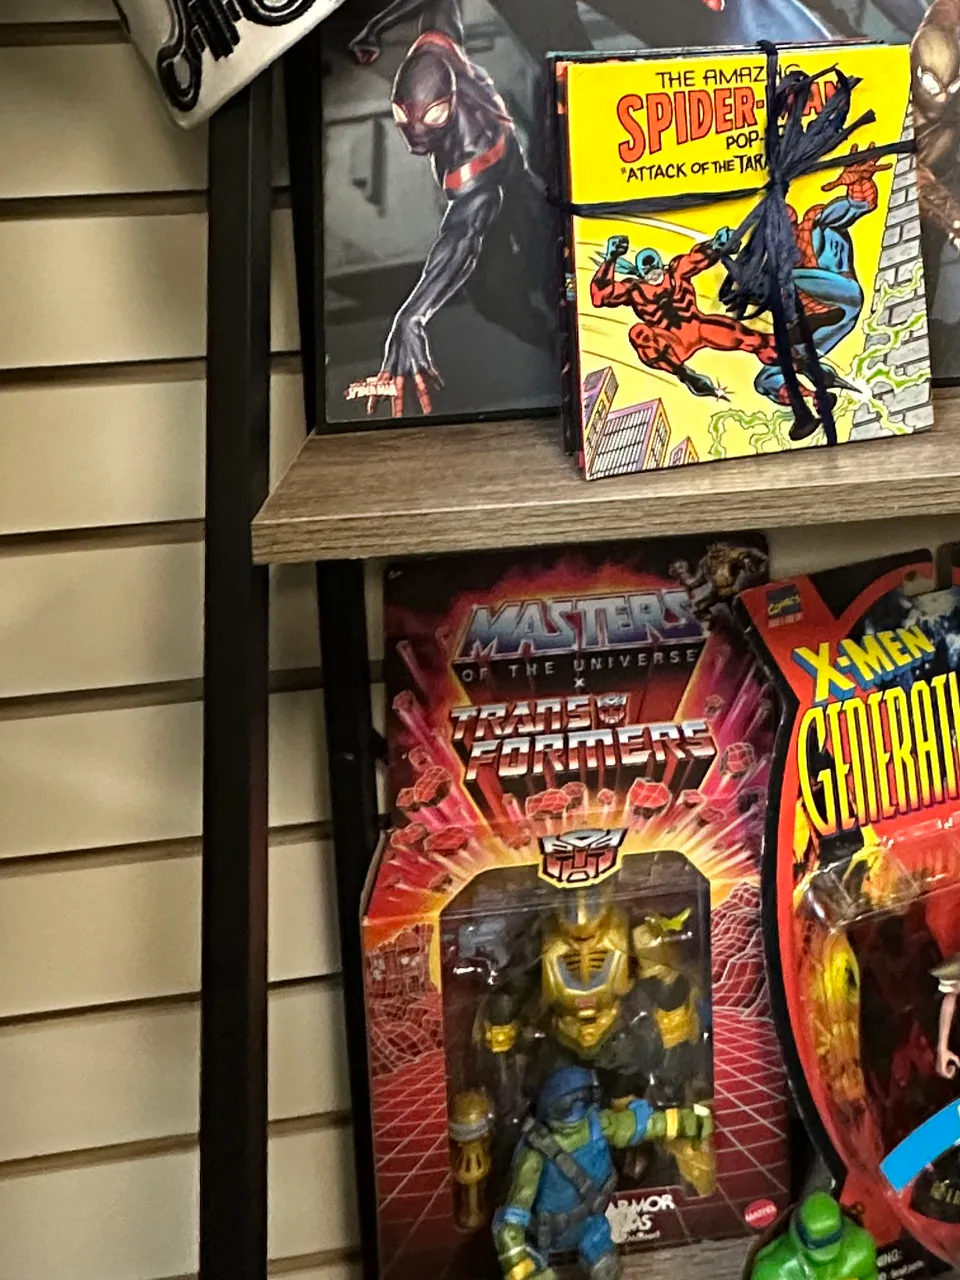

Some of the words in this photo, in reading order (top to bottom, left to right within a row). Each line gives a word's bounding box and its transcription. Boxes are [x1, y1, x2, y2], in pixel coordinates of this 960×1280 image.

[656, 70, 696, 89] THE
[690, 161, 709, 175] OF
[710, 159, 735, 173] THE
[452, 588, 709, 664] MASTERS
[461, 667, 489, 682] OF
[508, 661, 555, 678] THE
[573, 648, 699, 671] UNIVERSE
[794, 624, 936, 704] X-MEN
[450, 694, 596, 741] TRANS
[465, 719, 716, 781] FORMERS
